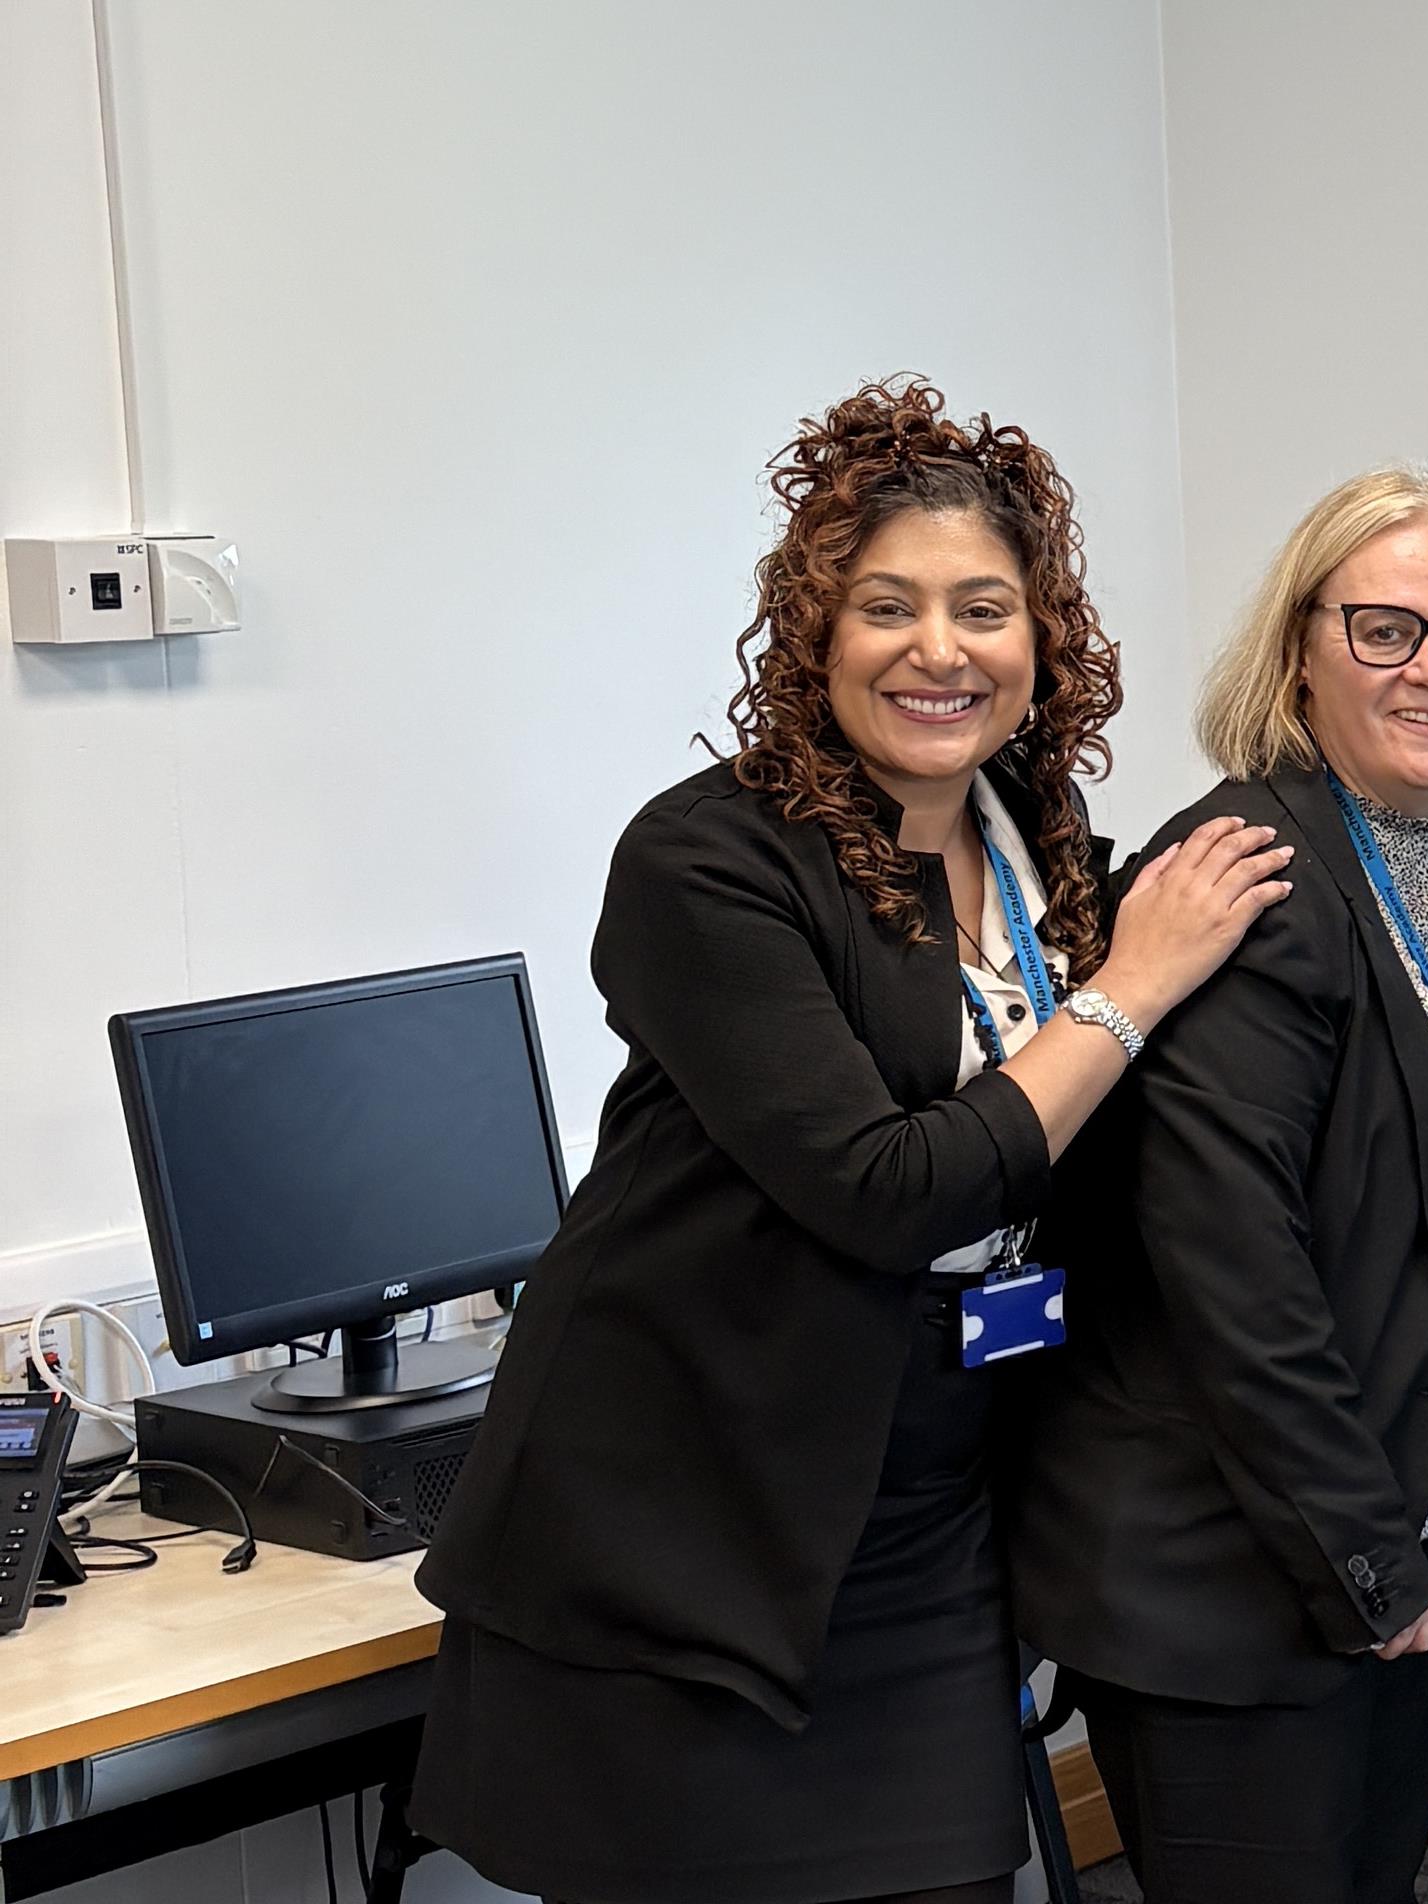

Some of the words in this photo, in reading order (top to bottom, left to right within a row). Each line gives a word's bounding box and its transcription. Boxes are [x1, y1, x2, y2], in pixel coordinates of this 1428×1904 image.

[1000, 863, 1023, 925] Academy
[1019, 929, 1050, 1012] Manchester
[383, 1282, 409, 1300] AOC
